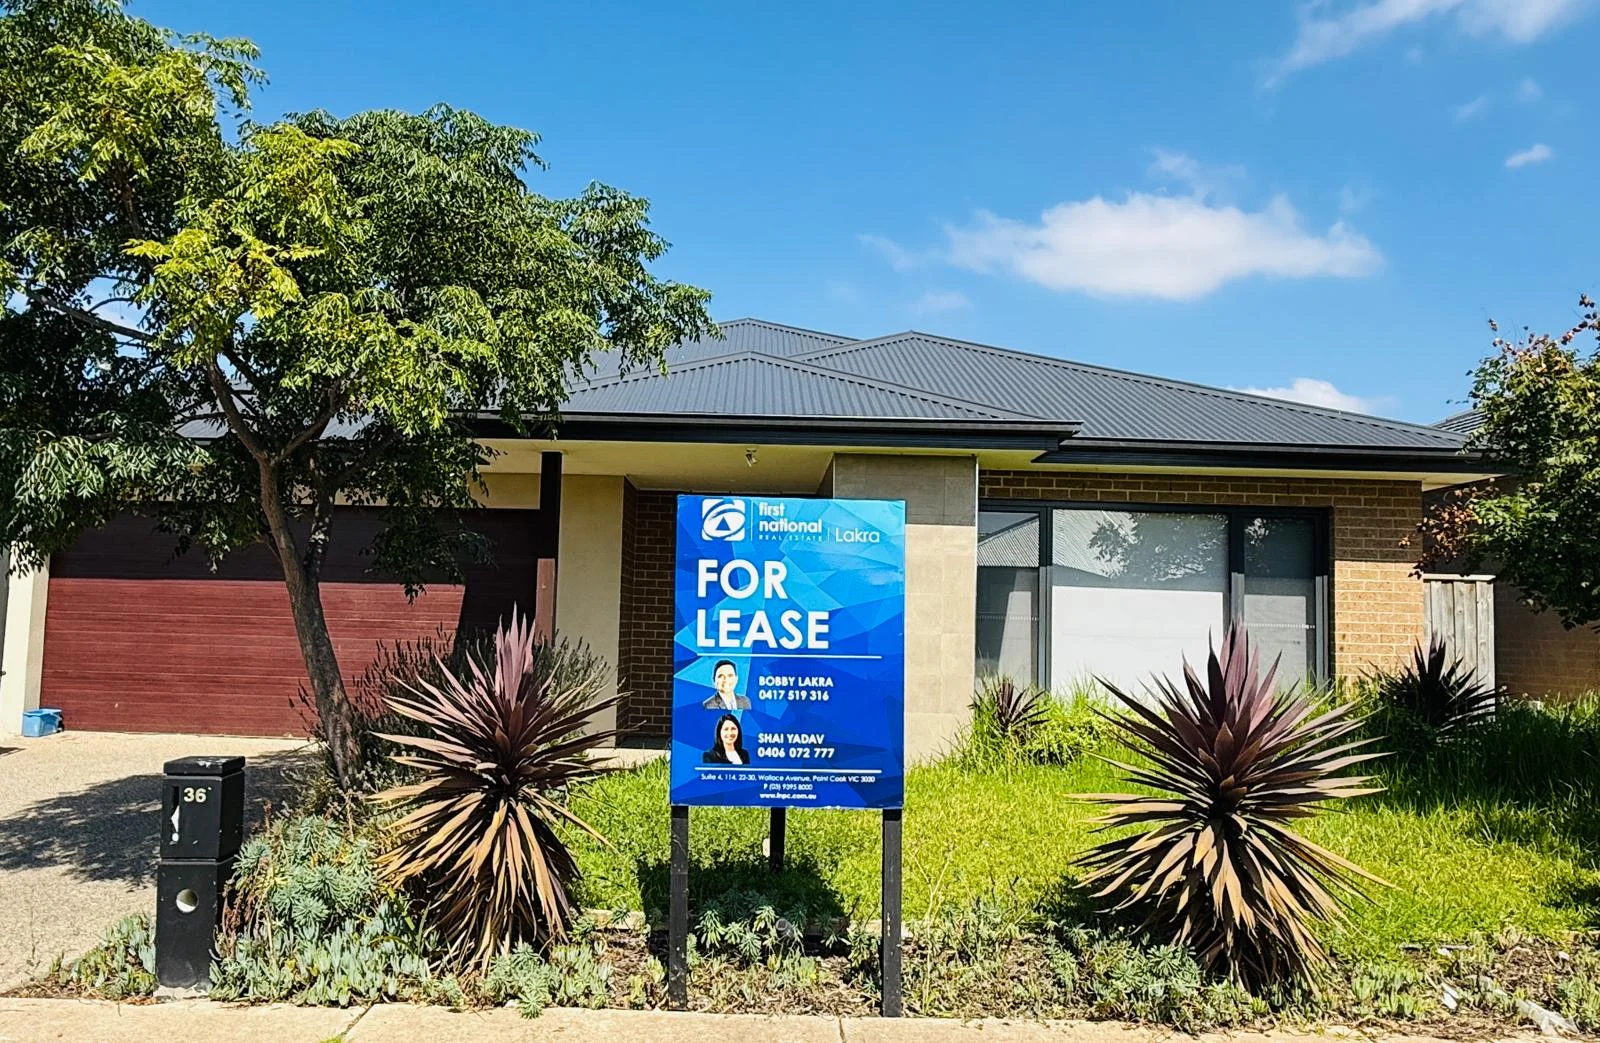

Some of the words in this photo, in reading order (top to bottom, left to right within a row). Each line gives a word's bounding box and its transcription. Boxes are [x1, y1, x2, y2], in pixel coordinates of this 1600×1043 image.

[758, 502, 785, 517] first
[758, 518, 823, 533] national
[835, 527, 880, 543] Lakra
[697, 558, 789, 600] FOR
[696, 609, 830, 650] LEASE
[758, 676, 795, 688] BOBBY
[798, 676, 834, 688] LAKRA
[758, 689, 785, 701] 0417
[787, 690, 807, 702] 519
[809, 690, 830, 702] 316
[757, 733, 784, 745] SHAI
[787, 733, 825, 745] YADAV
[757, 747, 786, 759] 0406
[789, 747, 811, 759] 072
[813, 748, 836, 760] 777
[701, 773, 716, 781] Suite
[758, 774, 784, 782] Wallace
[848, 775, 860, 783] VIC
[183, 787, 207, 803] 36
